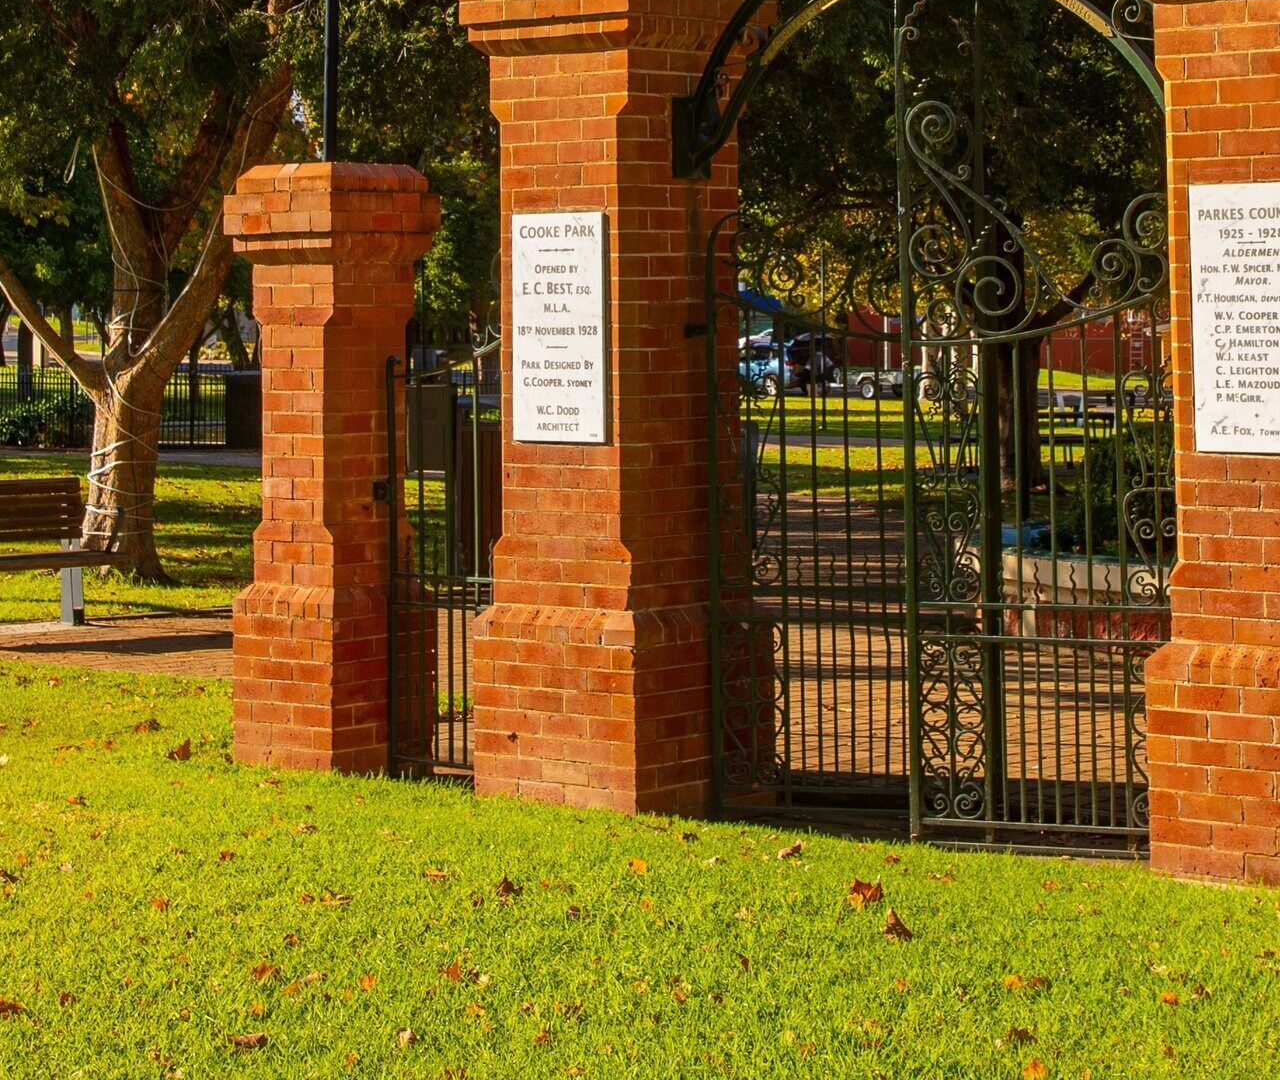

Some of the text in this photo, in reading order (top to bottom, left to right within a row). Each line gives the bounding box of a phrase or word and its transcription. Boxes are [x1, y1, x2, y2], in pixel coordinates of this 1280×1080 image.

[1198, 208, 1244, 221] PARKES
[519, 224, 595, 239] COOKE PARK
[1219, 229, 1244, 239] 1925
[534, 264, 567, 274] OPENED
[1235, 276, 1271, 285] MAYOR.
[522, 282, 531, 295] E.
[533, 282, 544, 295] C.
[543, 303, 571, 313] M.L.A.
[1214, 311, 1279, 320] W.V. COOPER
[535, 326, 576, 336] NOVEMBER
[578, 325, 598, 336] 1928
[1214, 325, 1232, 334] C.P.
[1229, 339, 1279, 348] HAMILTON
[1216, 352, 1269, 362] W.J. KEAST
[521, 360, 541, 370] PARK
[544, 360, 581, 370] DESIGNED
[1215, 366, 1279, 375] C. LEIGHTON
[567, 379, 593, 388] SYDNEY
[1216, 380, 1234, 389] L.E.
[1216, 393, 1223, 402] P.
[536, 405, 580, 416] W.C. DODD
[536, 422, 580, 432] ARCHITECT
[1210, 426, 1230, 435] A.E.
[1260, 428, 1280, 436] TOWN
